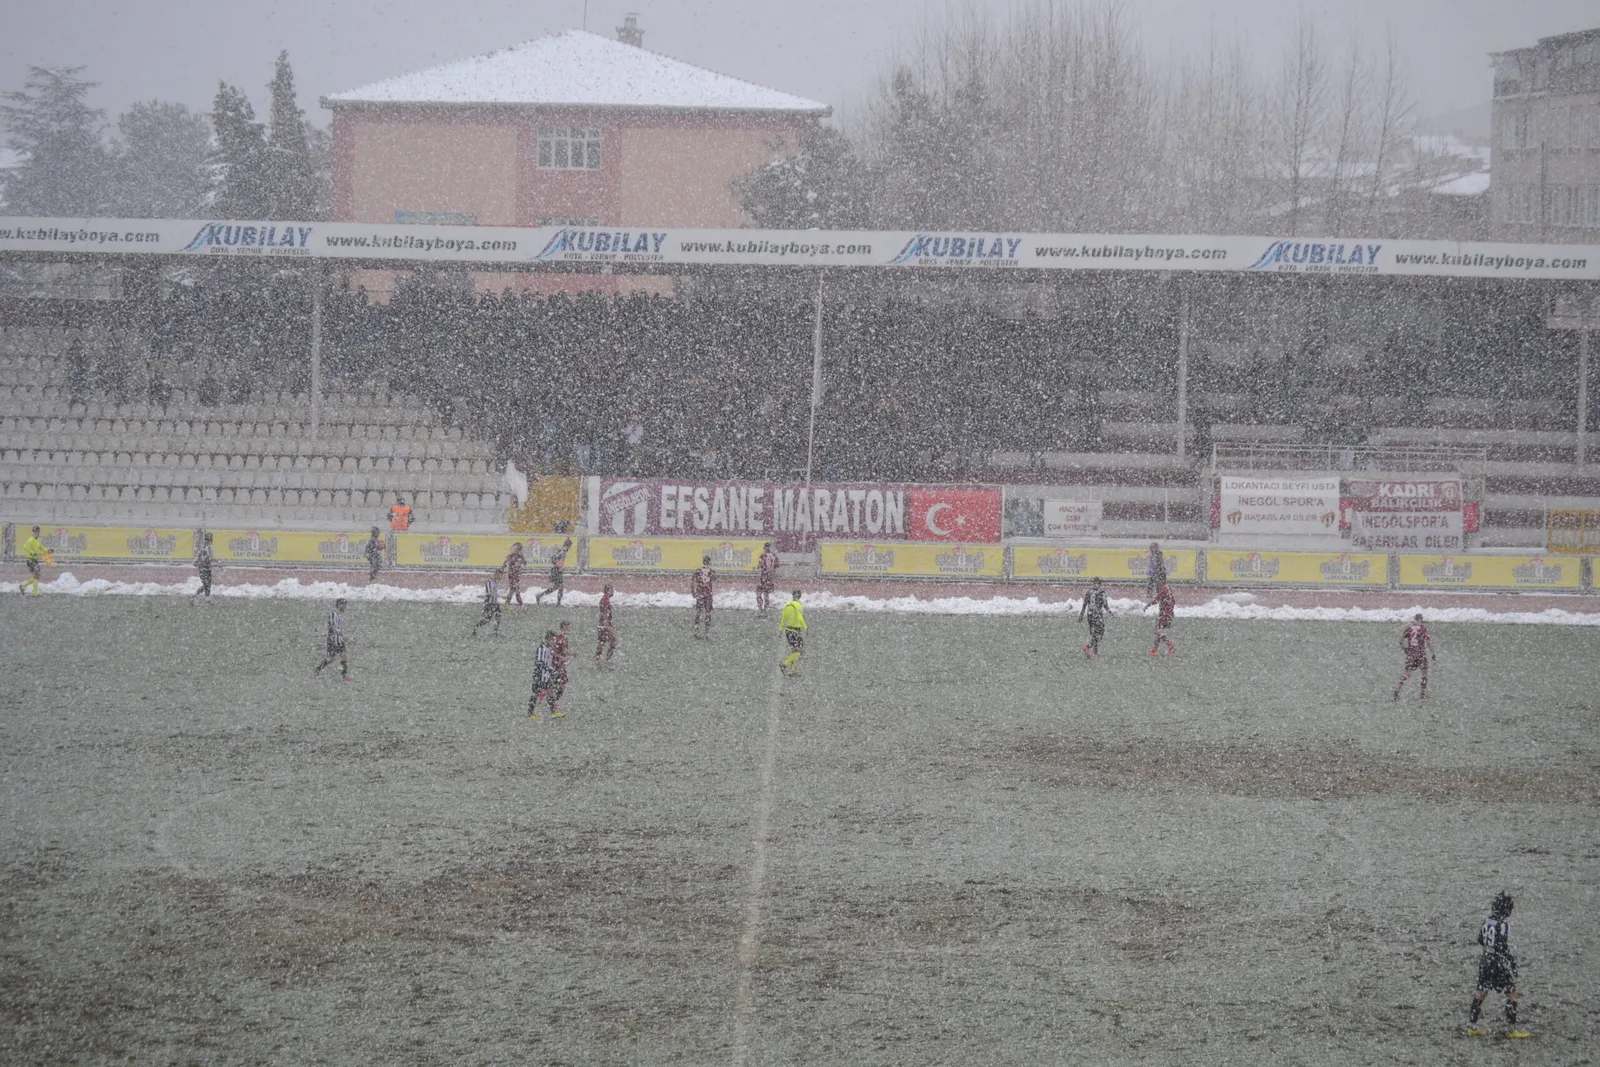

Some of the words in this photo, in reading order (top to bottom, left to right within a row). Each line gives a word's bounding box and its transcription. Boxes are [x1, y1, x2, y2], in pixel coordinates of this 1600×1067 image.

[326, 235, 517, 253] www.kubilayboya.com
[680, 239, 872, 258] www.kubilayboya.com
[1035, 245, 1227, 263] www.kubilayboya.com
[1395, 251, 1588, 270] www.kubilayboya.com
[660, 485, 764, 530] EFSANE
[773, 488, 904, 534] MARATON
[1482, 924, 1495, 946] 99
